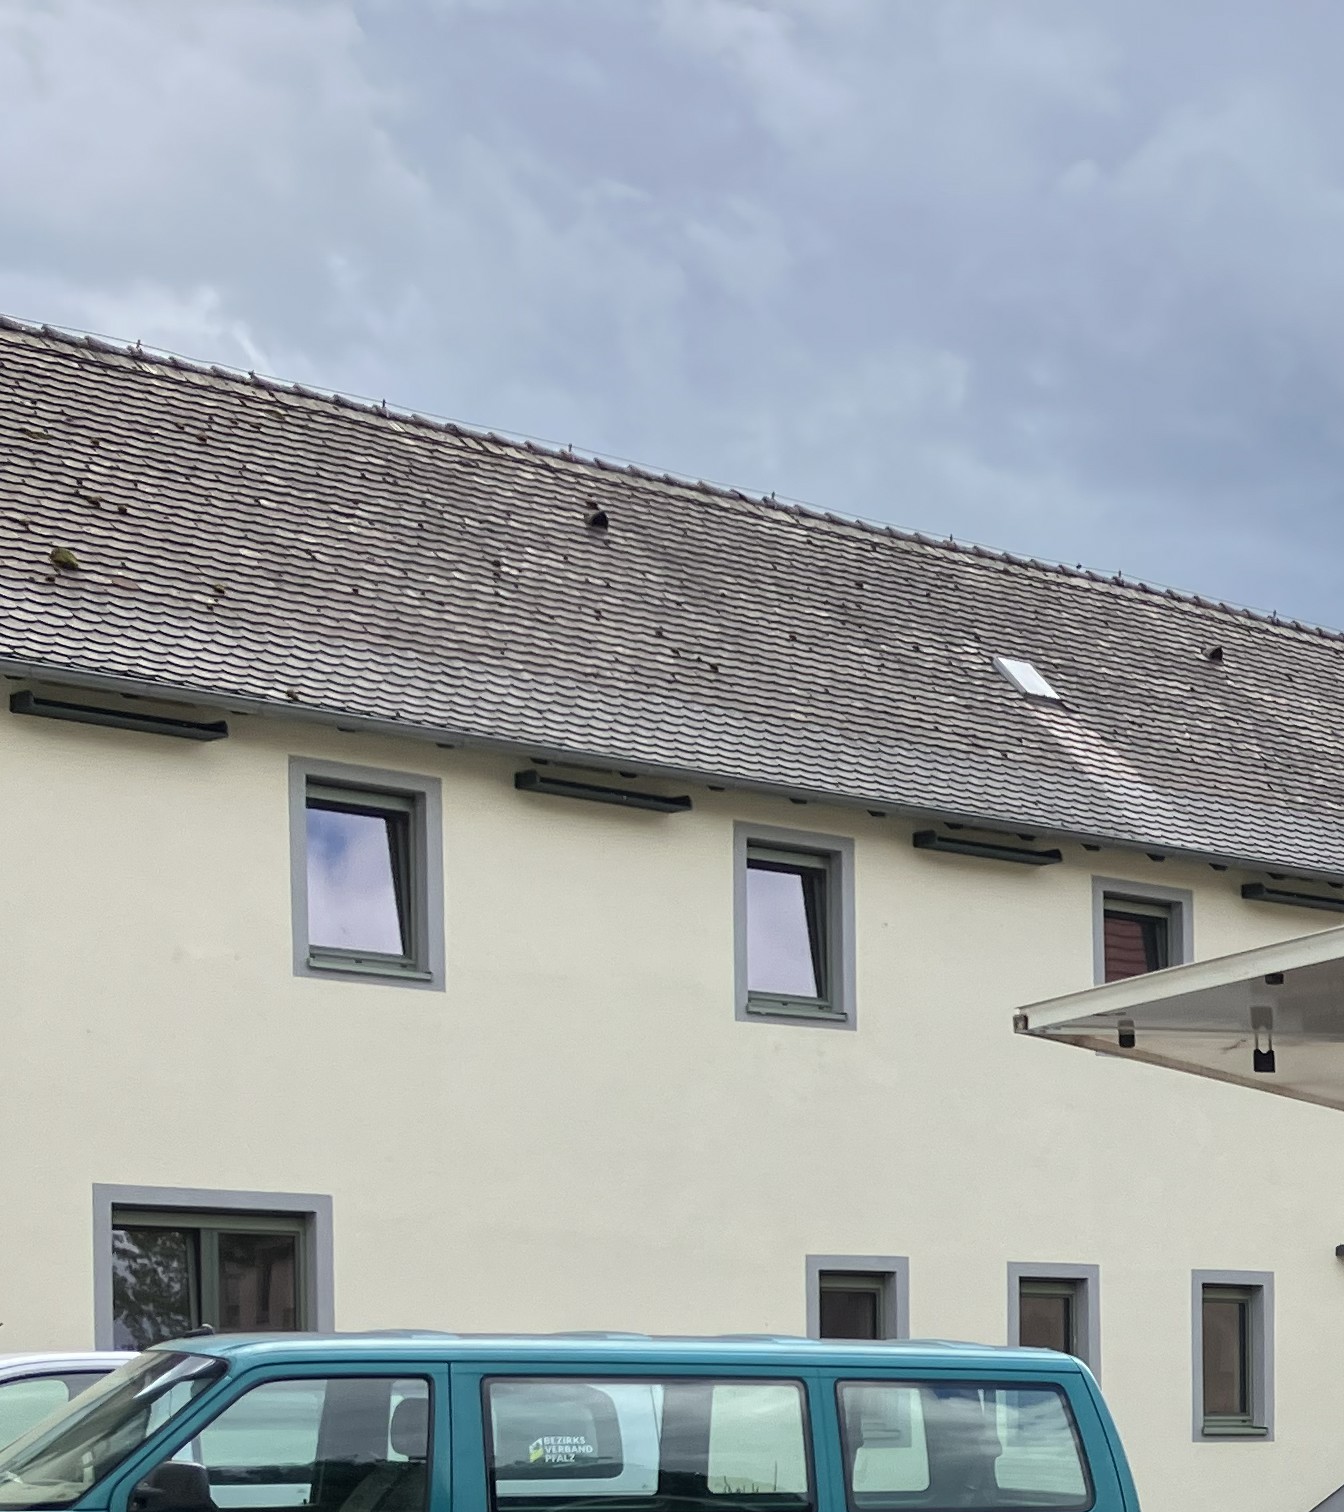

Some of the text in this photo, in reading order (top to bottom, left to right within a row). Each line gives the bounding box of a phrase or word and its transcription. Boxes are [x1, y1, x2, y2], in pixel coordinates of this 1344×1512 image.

[544, 1436, 586, 1445] BEZIRKS
[544, 1445, 594, 1454] VERBAND
[545, 1453, 576, 1463] PFALZ
